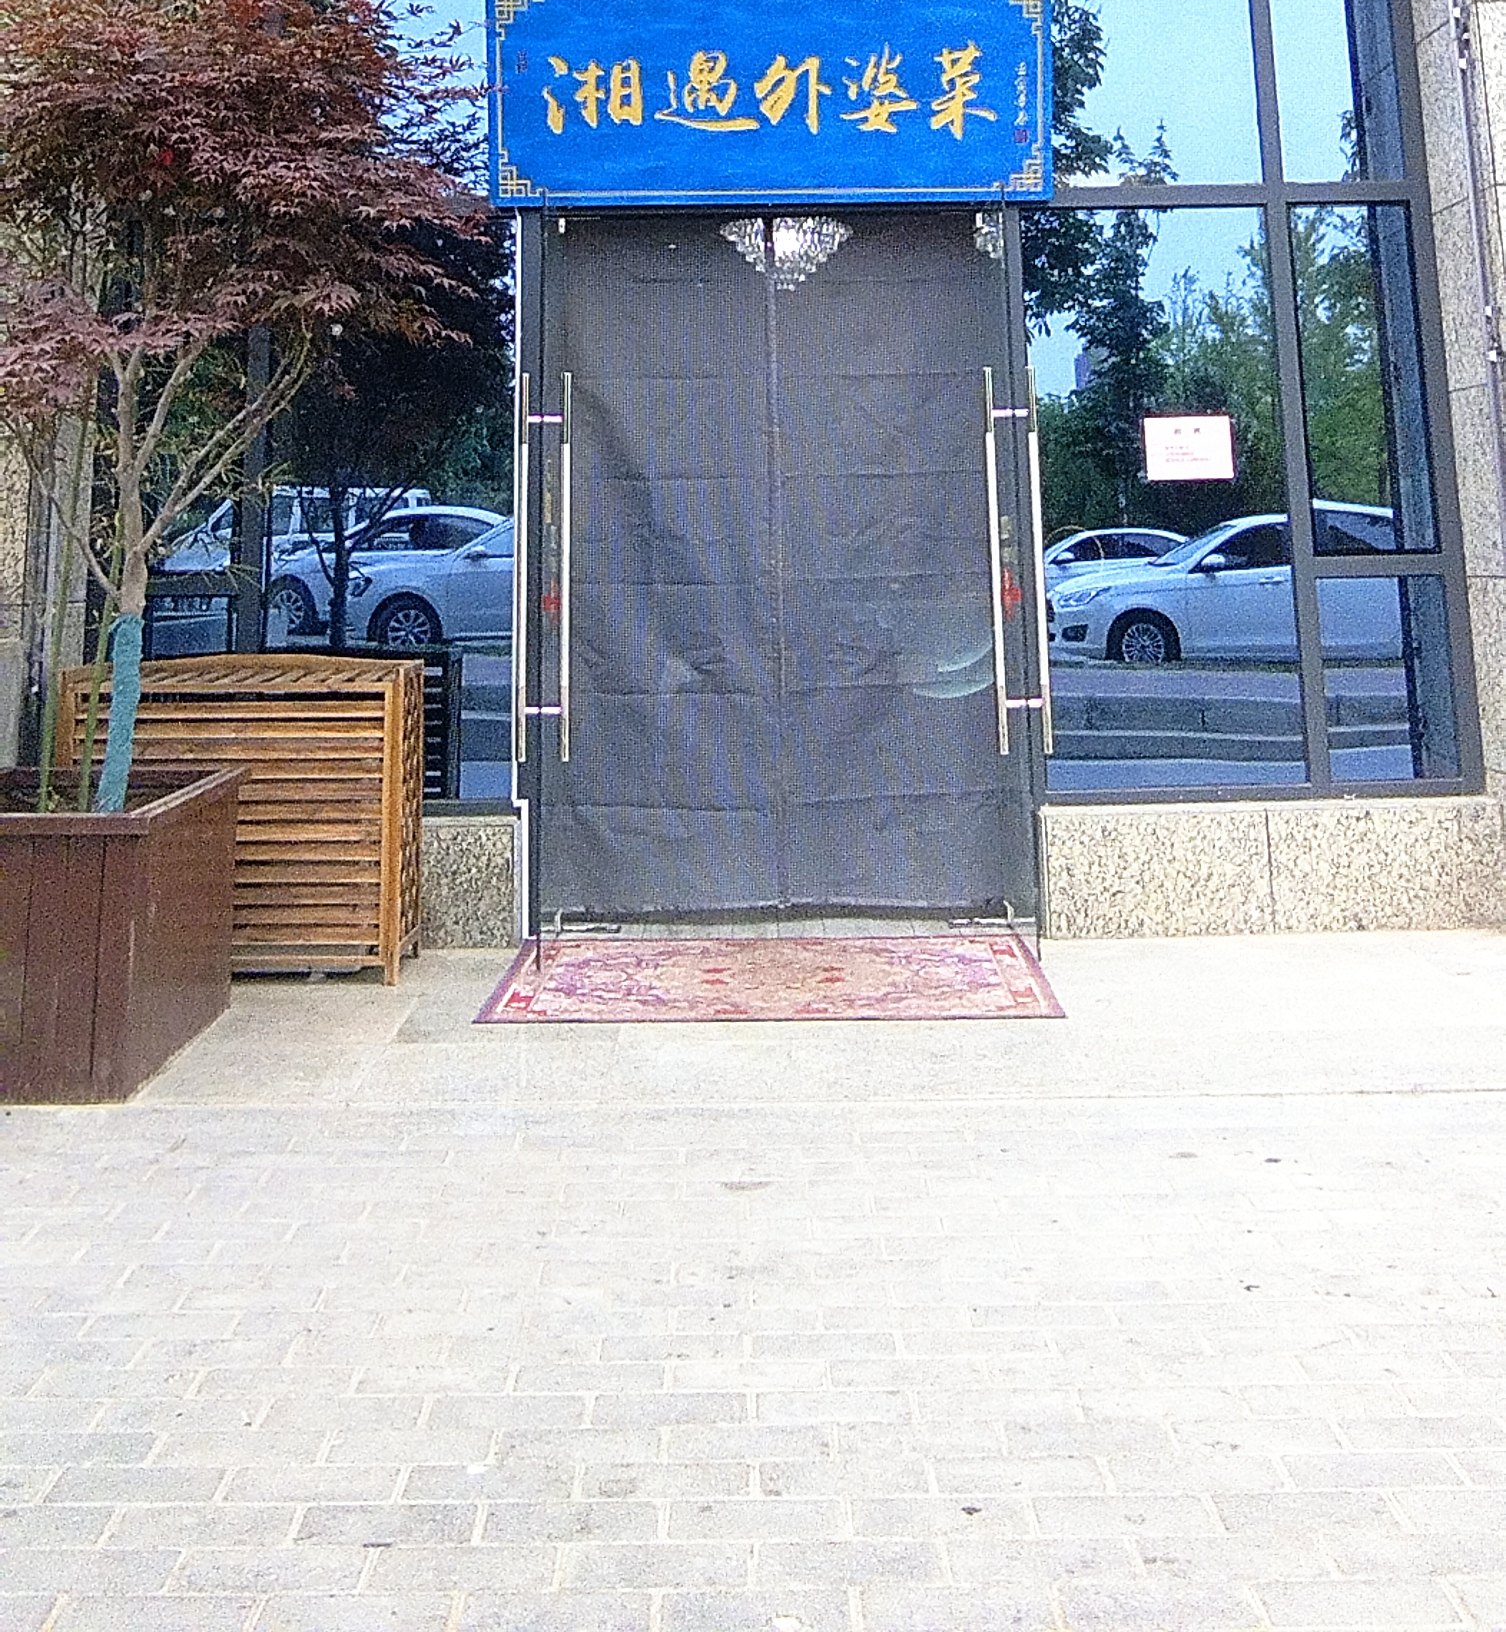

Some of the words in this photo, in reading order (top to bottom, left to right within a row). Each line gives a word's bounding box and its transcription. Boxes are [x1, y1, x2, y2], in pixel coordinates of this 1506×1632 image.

[543, 42, 997, 140] 湘遇外婆菜
